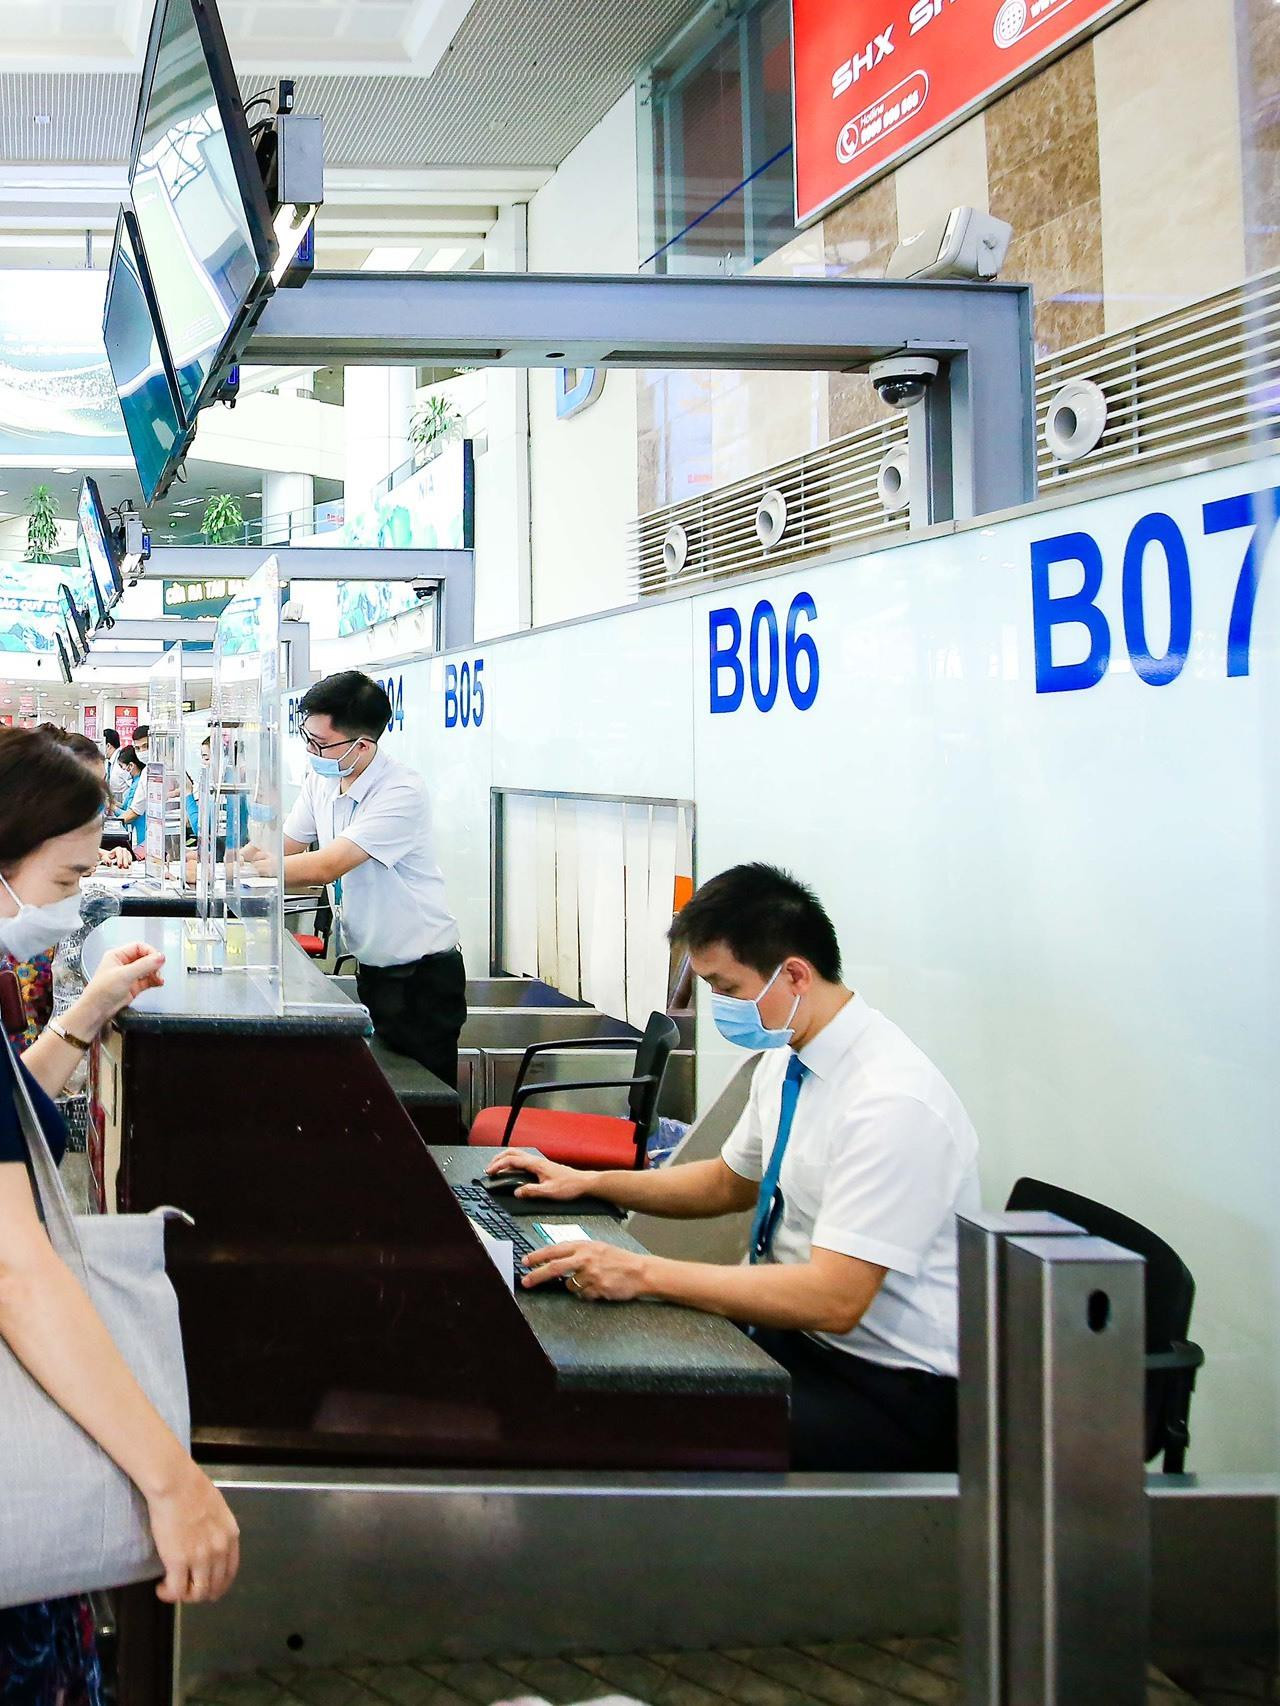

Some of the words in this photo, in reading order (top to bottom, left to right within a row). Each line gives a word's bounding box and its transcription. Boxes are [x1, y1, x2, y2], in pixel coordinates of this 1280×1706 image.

[832, 24, 895, 99] SHX
[1031, 486, 1280, 694] B07
[709, 592, 819, 714] B06
[377, 674, 404, 732] 04
[445, 659, 484, 728] B05
